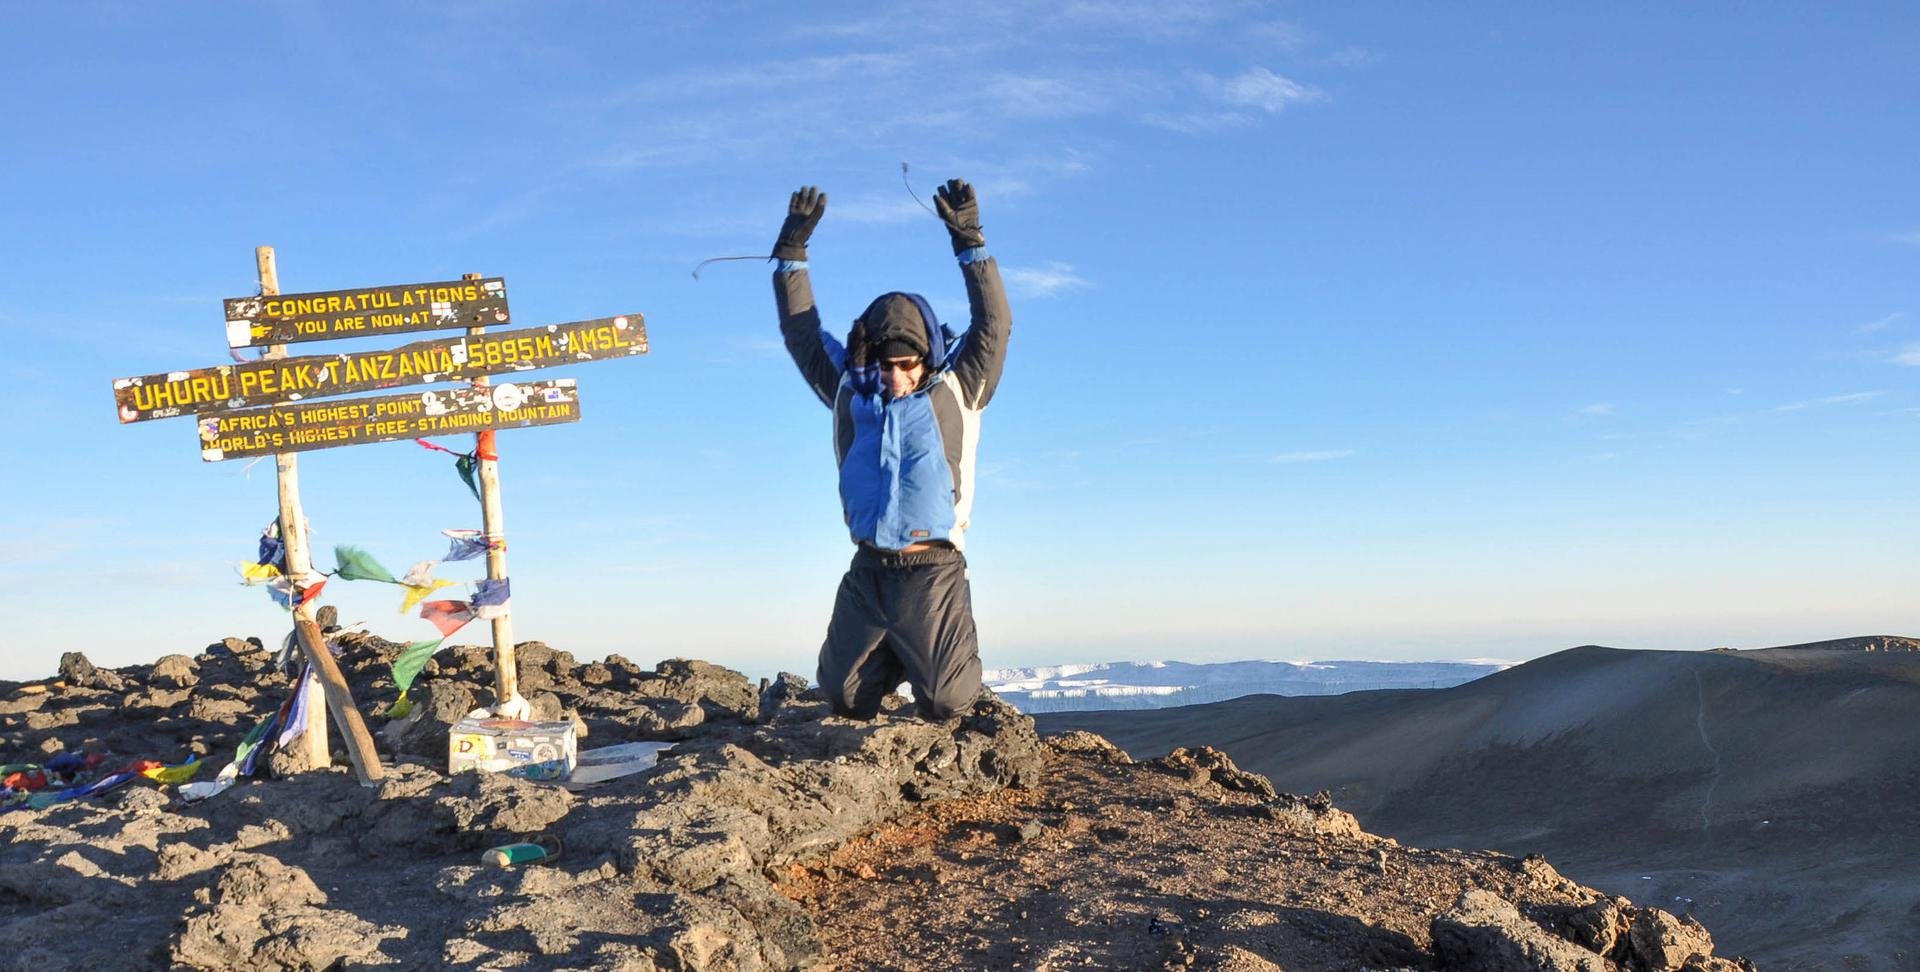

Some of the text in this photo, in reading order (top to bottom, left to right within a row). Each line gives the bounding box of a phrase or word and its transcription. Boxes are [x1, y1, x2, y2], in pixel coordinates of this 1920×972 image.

[294, 311, 430, 335] YOU ARE NOW AT
[132, 373, 231, 411] UHURU
[568, 326, 637, 354] AMSL.
[218, 400, 422, 433] AFRICA'S HIGHEST POINT
[289, 425, 359, 444] HIGHEST
[498, 403, 572, 424] MOUNTAIN
